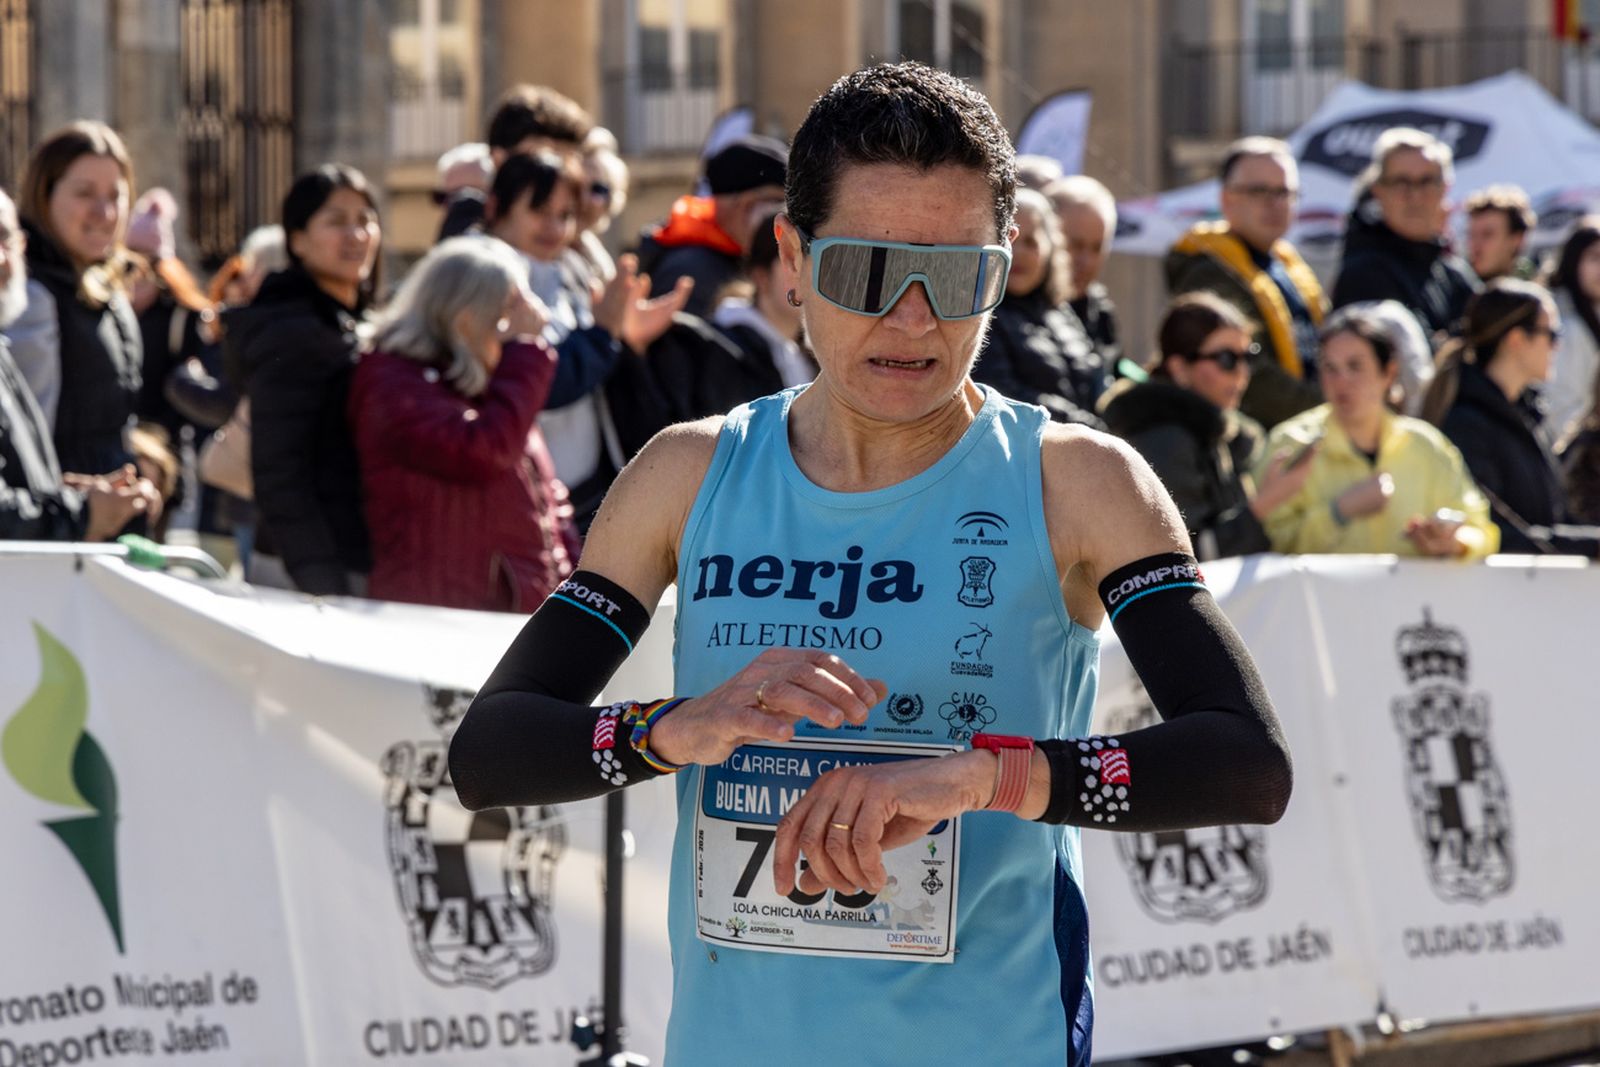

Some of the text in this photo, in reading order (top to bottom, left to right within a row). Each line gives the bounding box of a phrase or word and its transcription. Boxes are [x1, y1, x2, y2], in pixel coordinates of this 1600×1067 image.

[693, 545, 923, 619] nerja
[707, 621, 882, 650] ATLETISMO
[951, 691, 987, 706] CMD
[732, 753, 811, 777] CARRERA
[715, 780, 771, 815] BUENA
[733, 902, 877, 923] LOLA CHICLANA PARRILLA
[1098, 942, 1213, 988] CIUDAD
[1214, 935, 1256, 973] DE
[221, 970, 258, 1004] de
[363, 1014, 492, 1057] CIUDAD
[497, 1009, 540, 1048] DE
